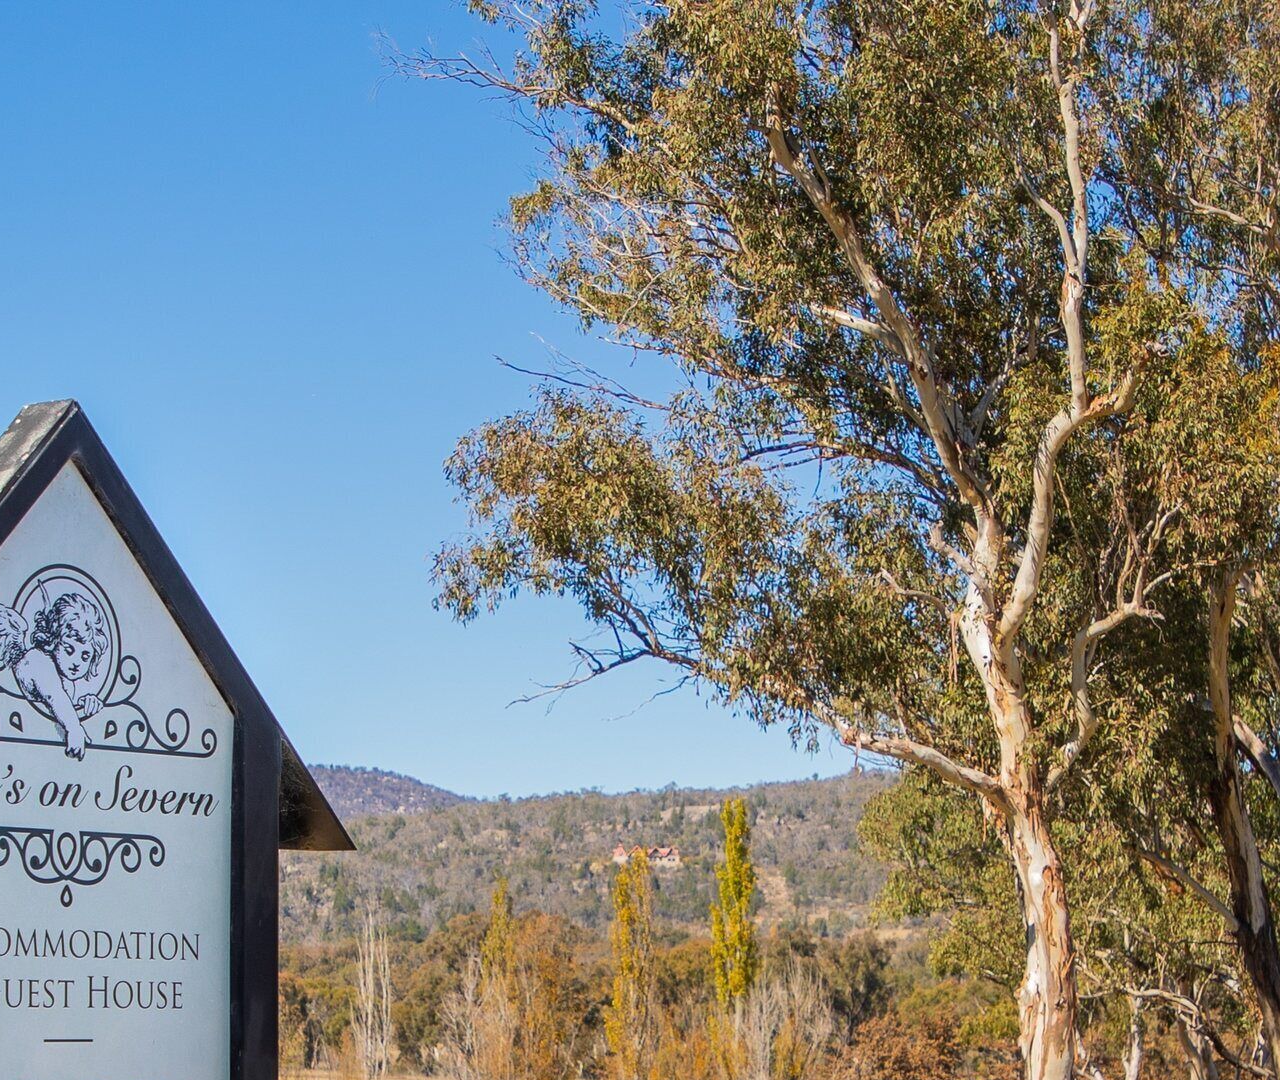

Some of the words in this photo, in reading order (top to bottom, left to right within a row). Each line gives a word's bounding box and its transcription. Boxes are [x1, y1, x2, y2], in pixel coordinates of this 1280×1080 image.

[39, 780, 88, 808] on
[95, 765, 219, 816] Severn
[87, 975, 183, 1010] HOUSE
